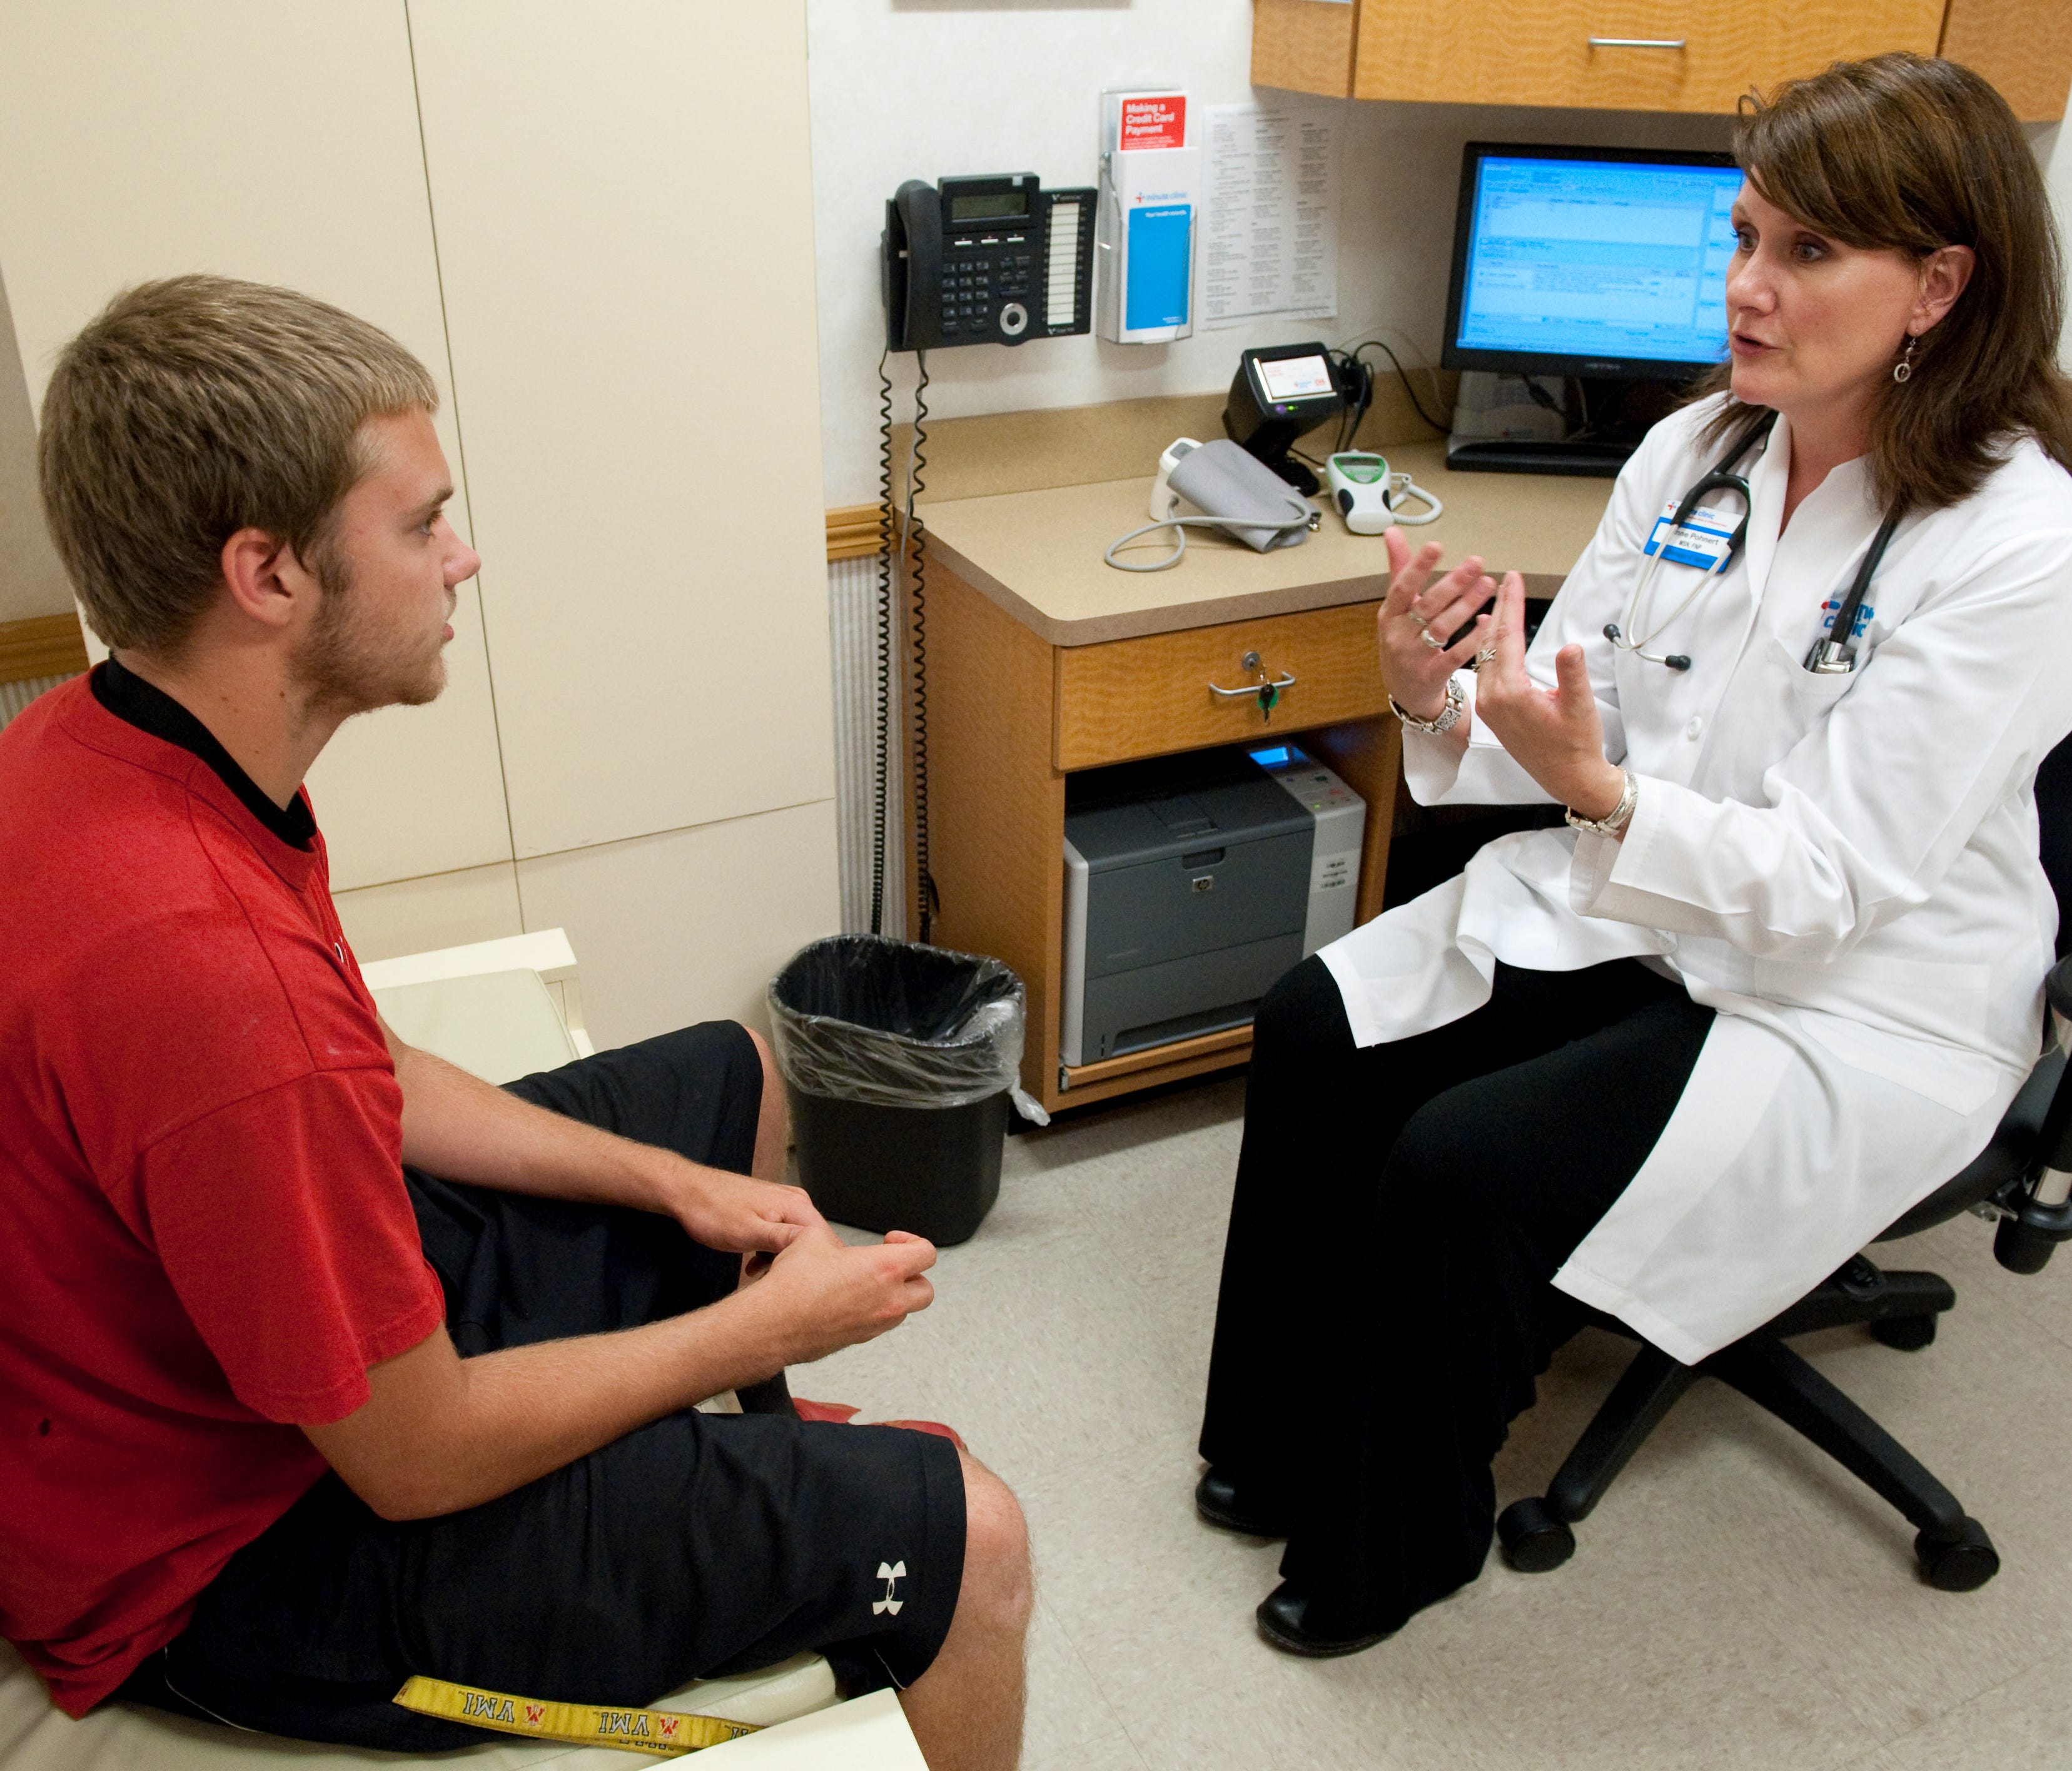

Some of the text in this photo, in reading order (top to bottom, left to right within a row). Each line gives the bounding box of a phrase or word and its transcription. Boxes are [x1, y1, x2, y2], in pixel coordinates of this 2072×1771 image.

[1126, 103, 1166, 113] Making a
[1126, 112, 1175, 124] Credit Card
[1126, 124, 1163, 136] Payment
[1698, 510, 1716, 520] clinic
[1673, 529, 1719, 546] nne Pohnert
[463, 1692, 515, 1723] VMI
[599, 1712, 650, 1737] VMI
